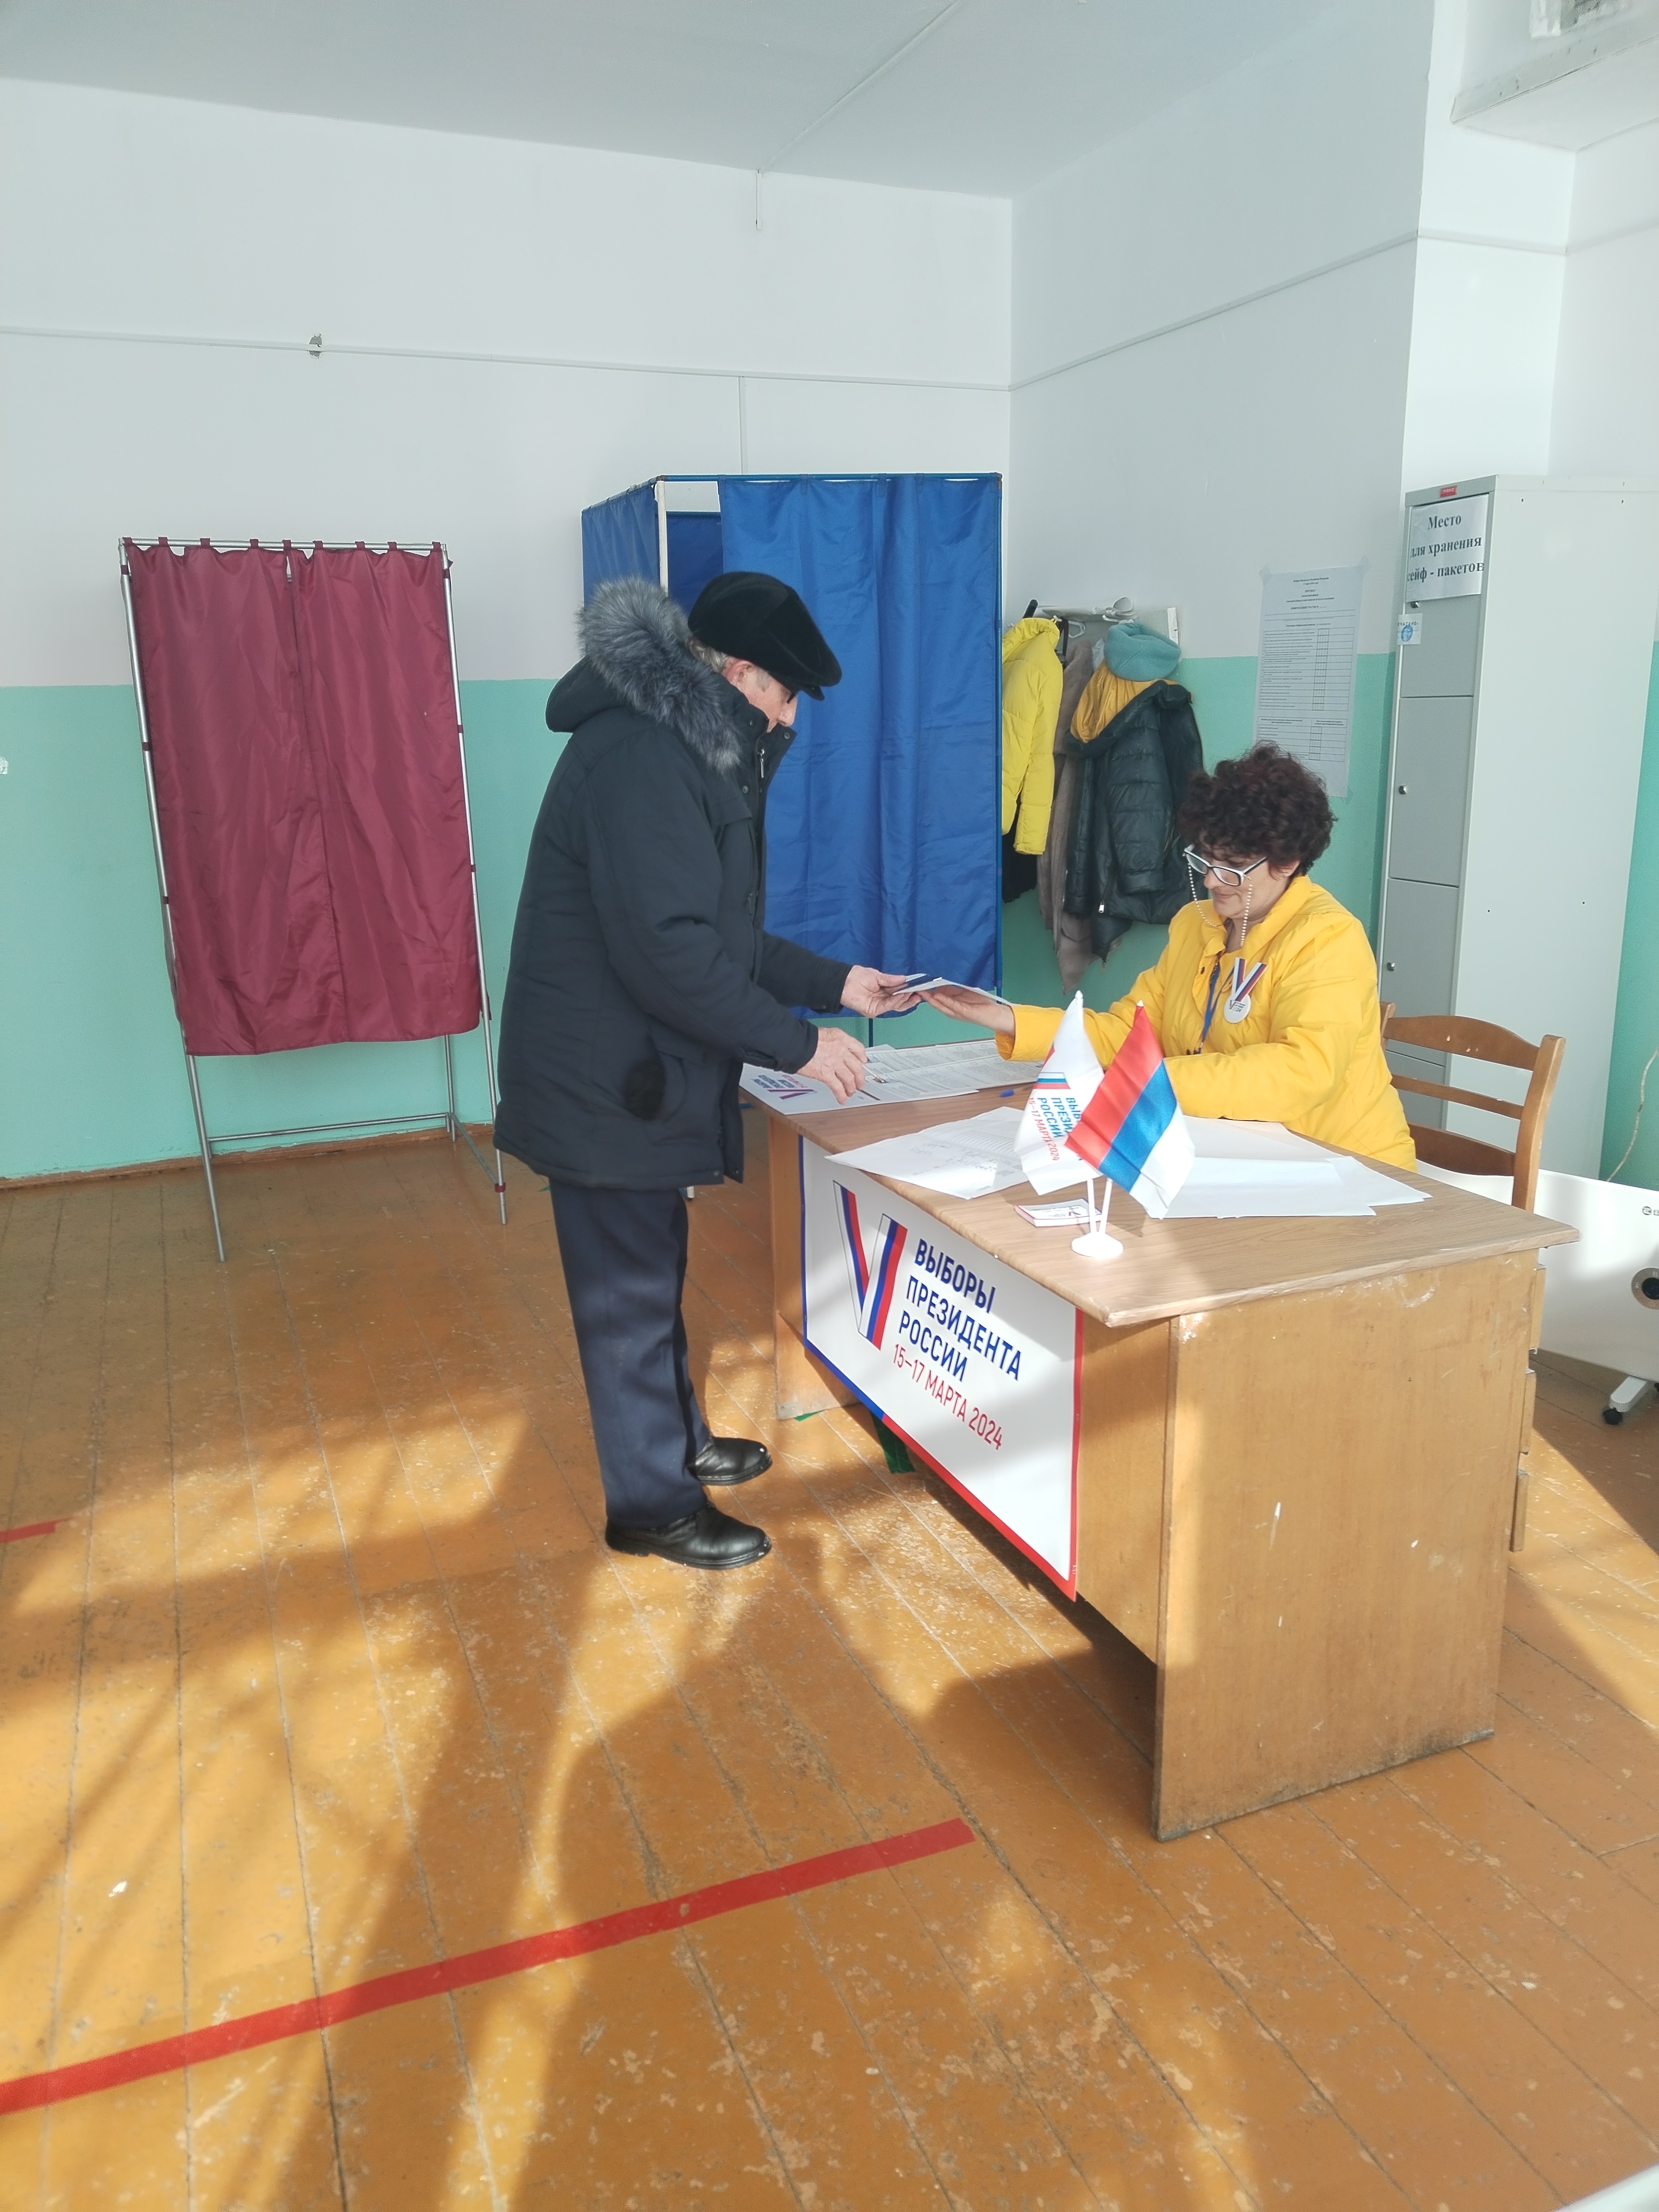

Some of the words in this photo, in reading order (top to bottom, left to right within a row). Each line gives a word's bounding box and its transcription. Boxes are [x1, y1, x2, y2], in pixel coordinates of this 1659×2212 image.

[1428, 515, 1462, 530] Место
[1410, 546, 1426, 558] для
[1428, 537, 1482, 557] хранения
[1407, 566, 1427, 583] сейф
[1437, 562, 1485, 577] пакетов
[1037, 1097, 1064, 1138] РОССИИ
[1051, 1097, 1073, 1134] ПРЕЗИ
[1065, 1097, 1082, 1122] ВЫБ
[1047, 1143, 1060, 1161] 2024
[914, 1238, 997, 1314] ВЫБОРЫ
[898, 1309, 968, 1383] РОССИИ
[905, 1274, 1022, 1382] ПРЕЗИДЕНТА
[924, 1369, 967, 1423] МАРТА
[968, 1407, 1002, 1451] 2024
